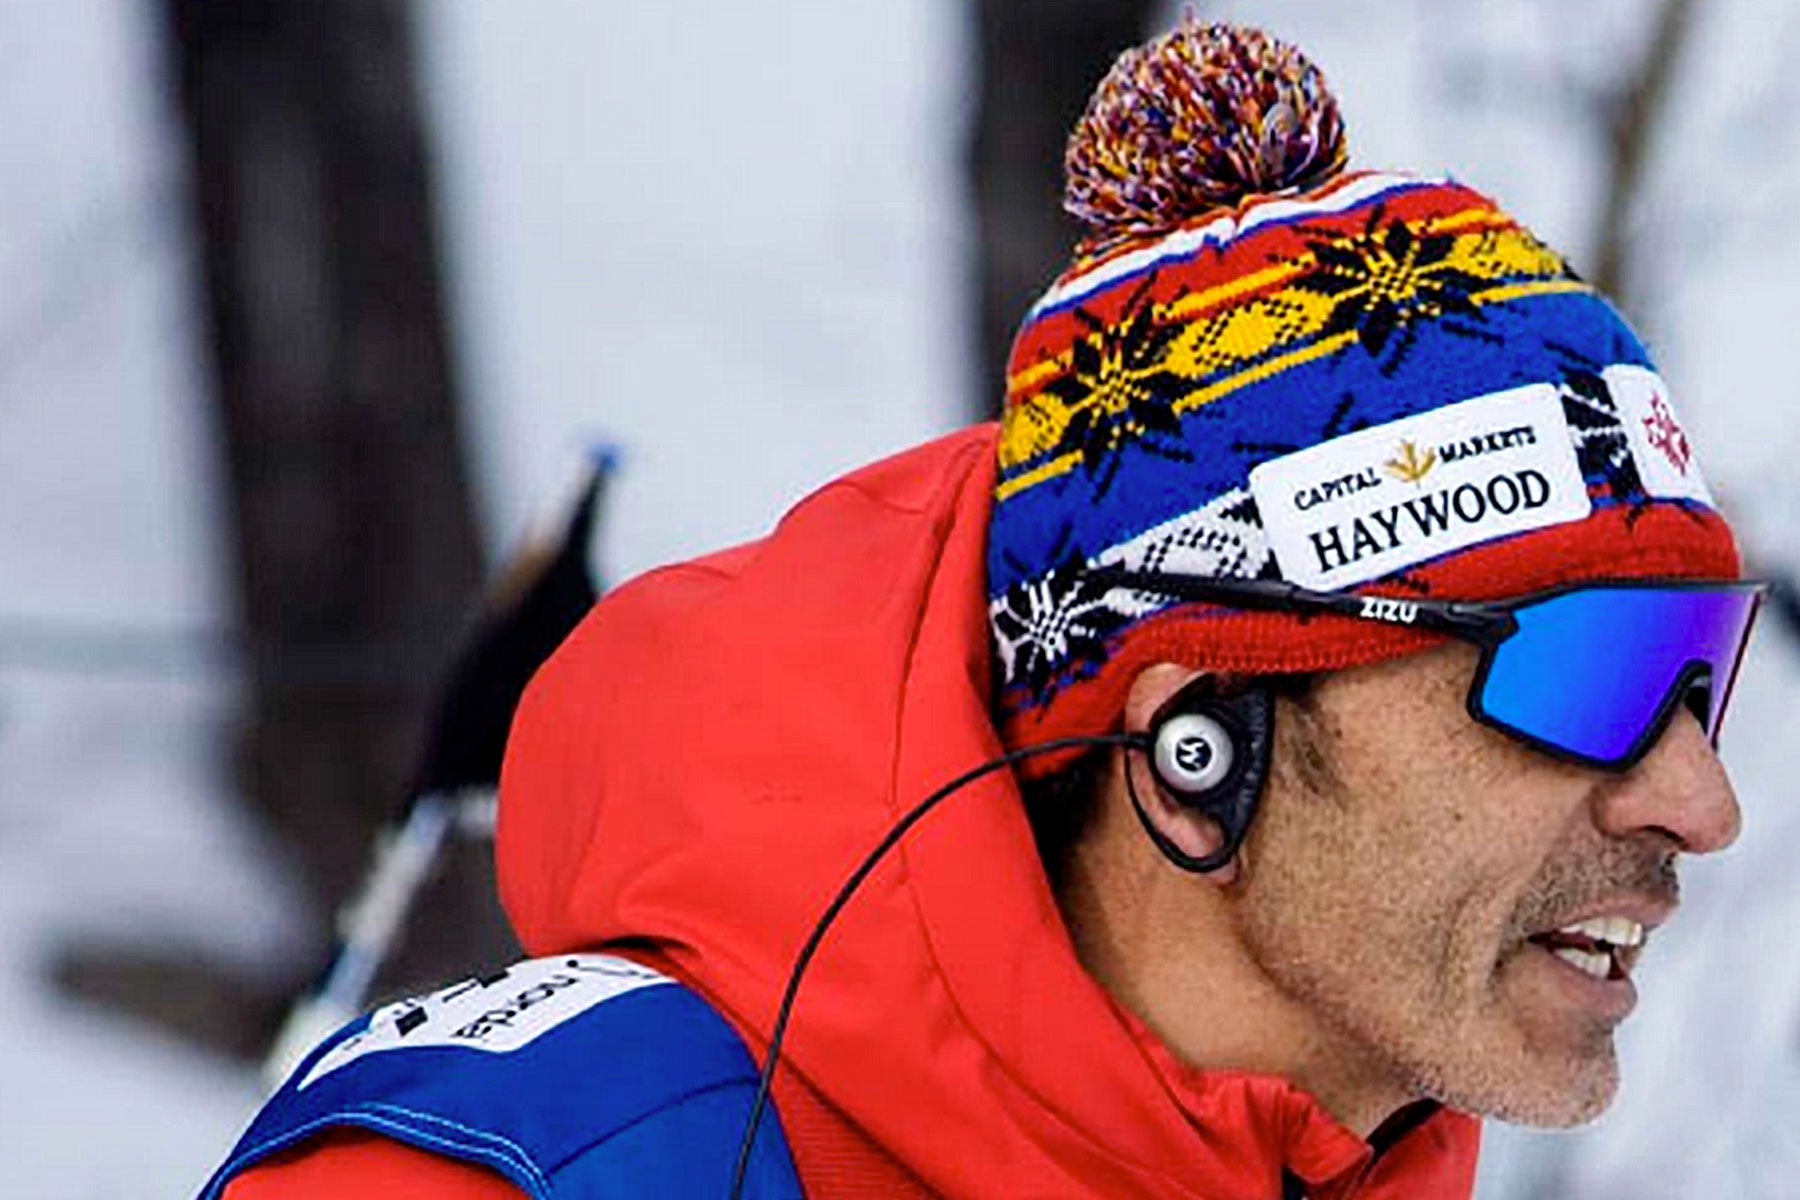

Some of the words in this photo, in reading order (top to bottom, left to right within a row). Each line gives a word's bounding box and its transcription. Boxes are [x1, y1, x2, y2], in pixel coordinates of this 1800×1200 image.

[1294, 467, 1382, 511] CAPITAL
[1439, 425, 1536, 463] MARKETS
[1309, 469, 1549, 573] HAYWOOD
[1360, 596, 1418, 624] ZIZU
